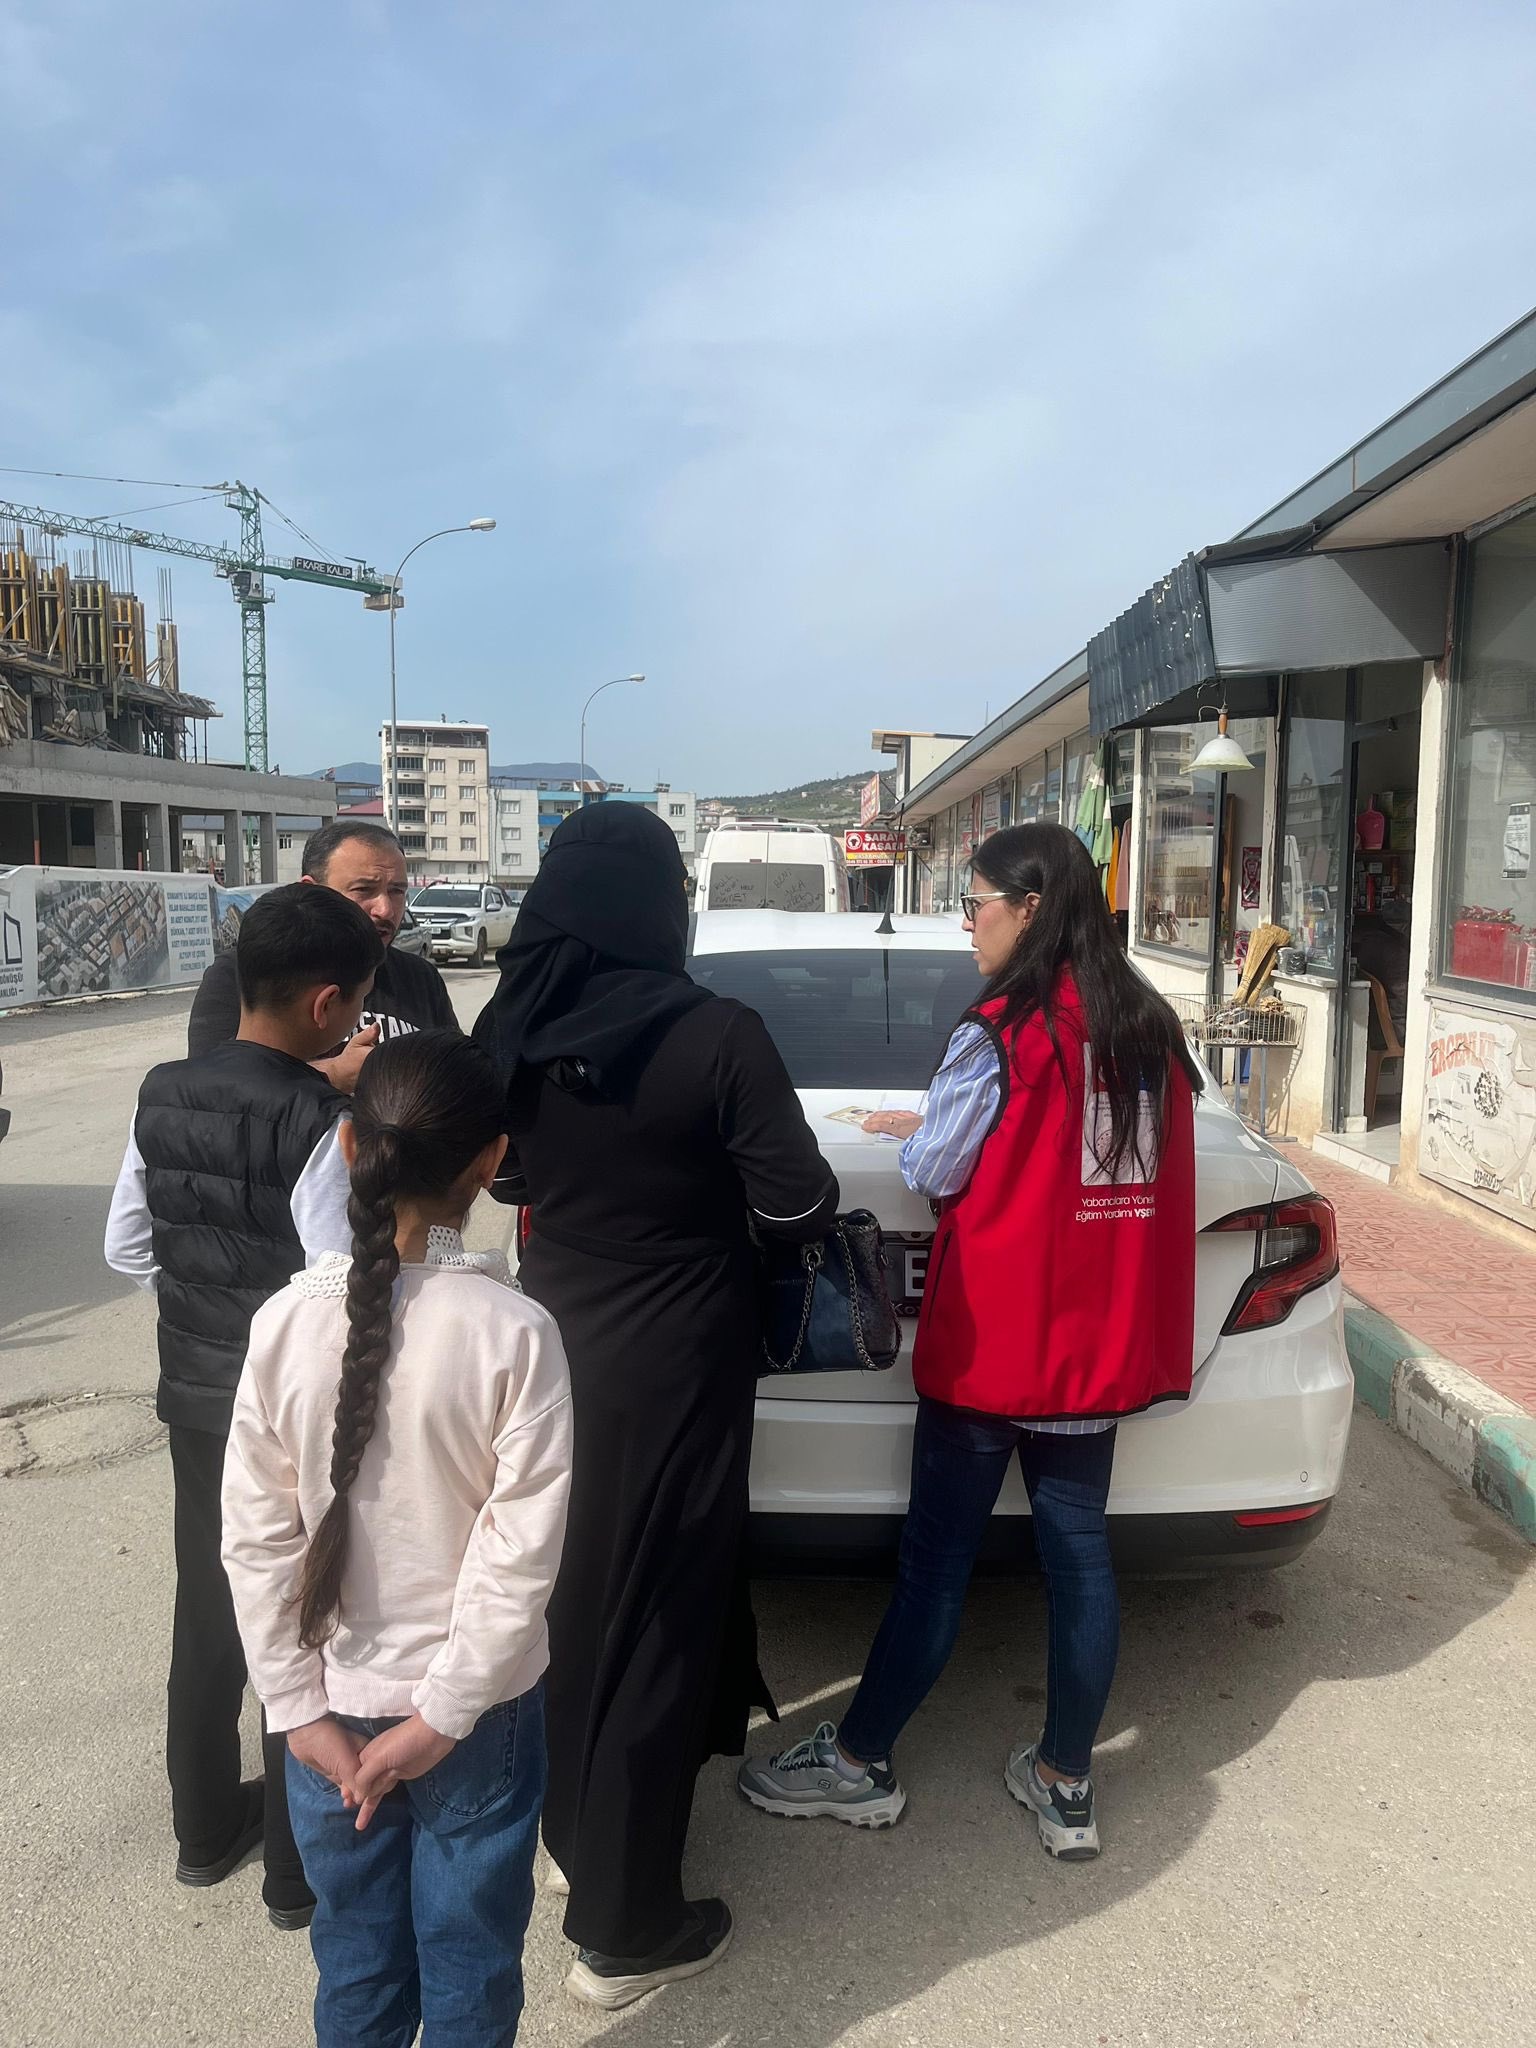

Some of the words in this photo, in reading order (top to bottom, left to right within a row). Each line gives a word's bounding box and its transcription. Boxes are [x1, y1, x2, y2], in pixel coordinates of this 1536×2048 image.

[303, 560, 325, 573] KARE
[327, 564, 351, 577] KALIP
[1075, 1211, 1102, 1223] Eğitim
